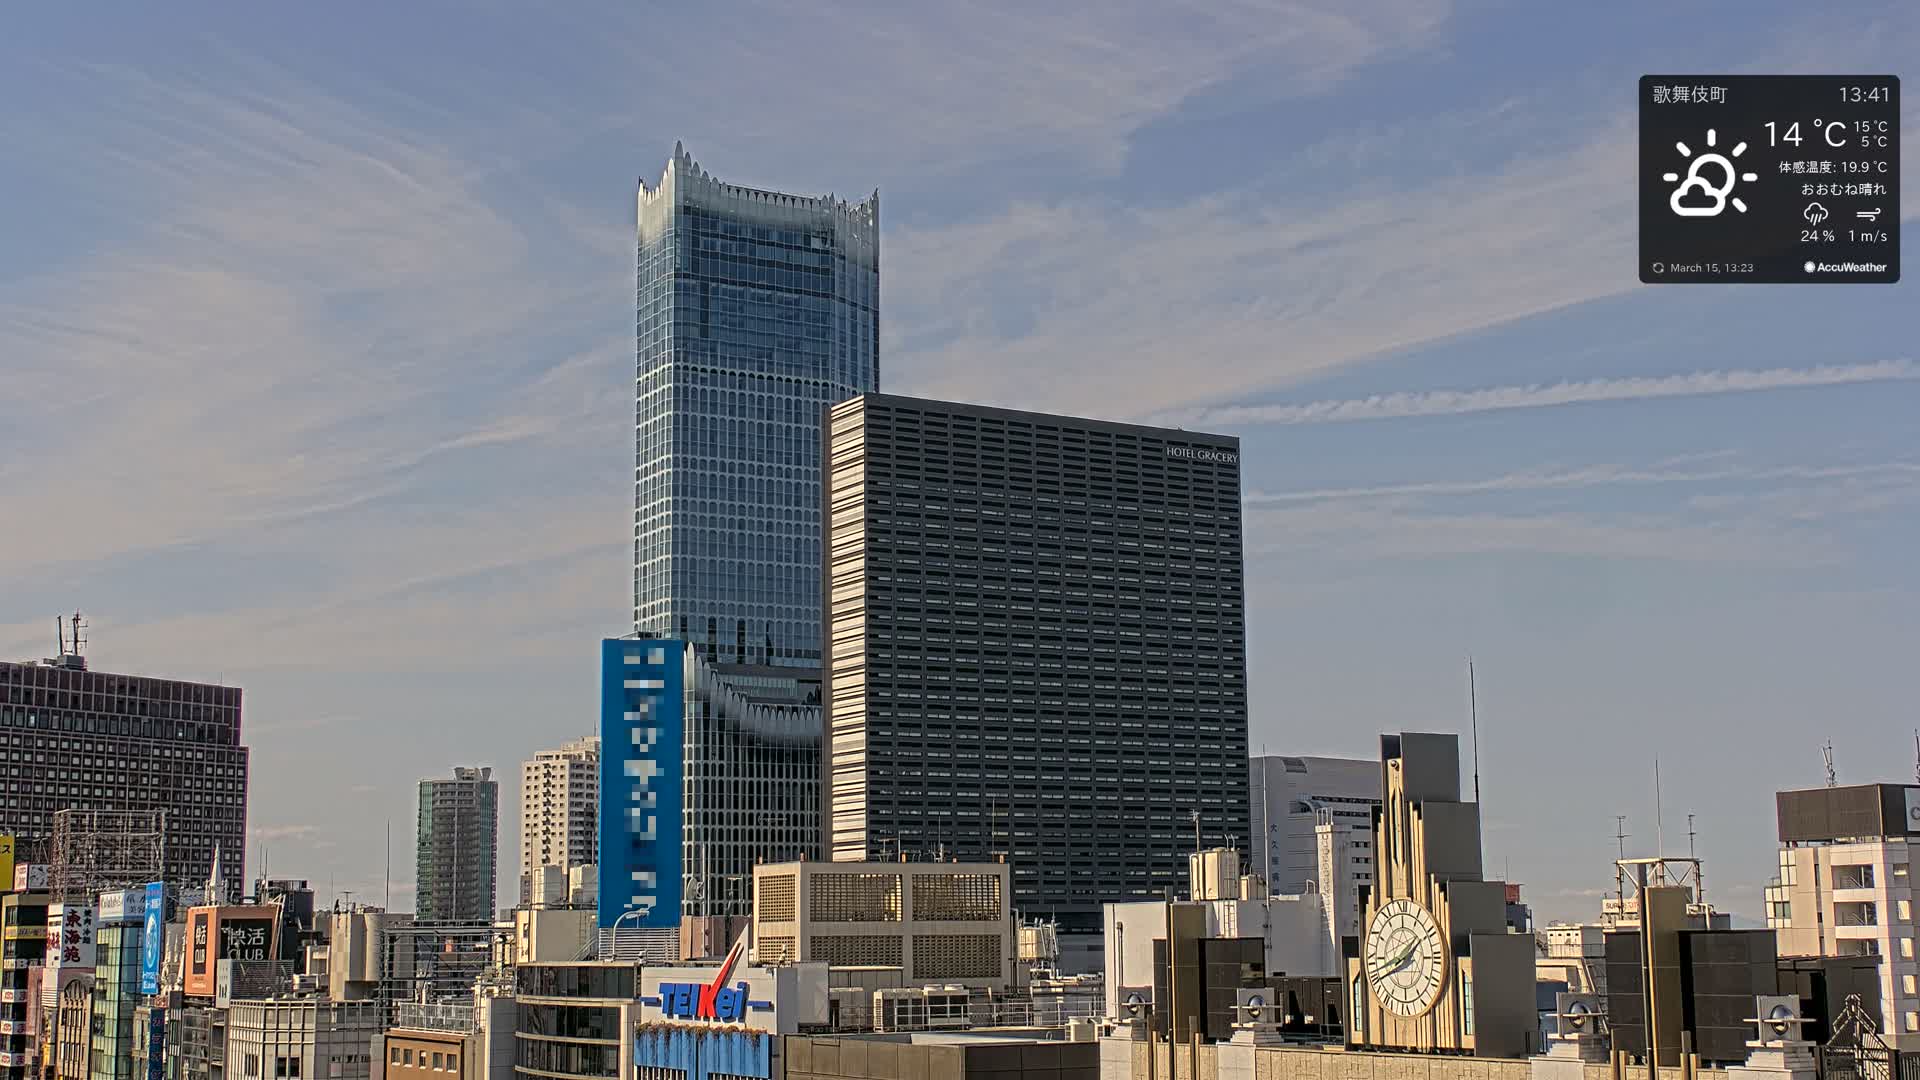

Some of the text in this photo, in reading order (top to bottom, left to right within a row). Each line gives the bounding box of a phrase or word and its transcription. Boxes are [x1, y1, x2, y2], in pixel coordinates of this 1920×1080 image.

[1166, 447, 1239, 463] HOTEL GRACERY
[64, 908, 82, 963] 東海苑
[230, 927, 265, 945] 快活
[228, 948, 264, 960] CLUB
